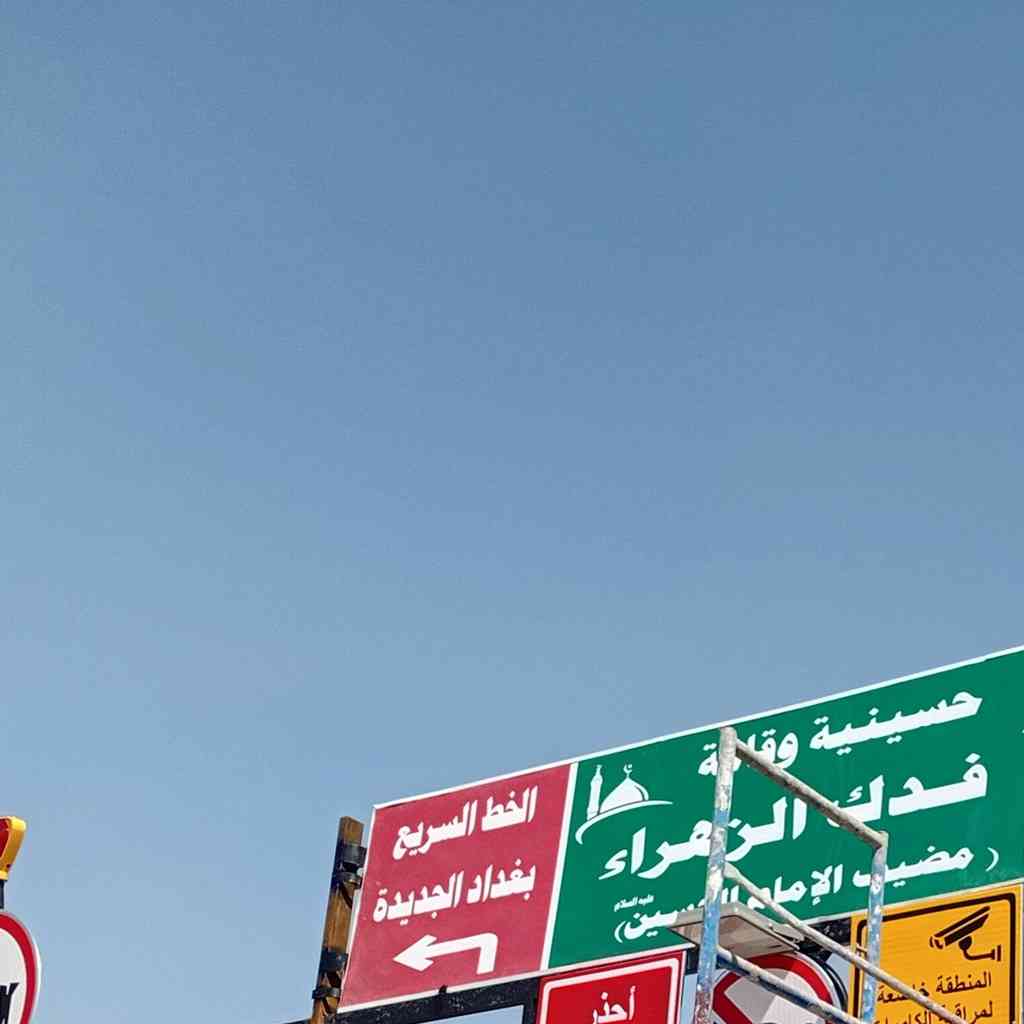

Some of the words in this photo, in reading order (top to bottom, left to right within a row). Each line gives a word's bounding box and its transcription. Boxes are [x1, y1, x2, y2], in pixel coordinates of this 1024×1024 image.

[809, 691, 983, 755] حسينية
[698, 728, 799, 776] وقاة
[481, 786, 538, 831] الخط
[827, 752, 988, 825] فدك
[392, 800, 478, 860] السريع
[599, 796, 808, 879] الزهراء
[373, 870, 464, 925] الجديدة
[466, 858, 536, 904] بغداد
[877, 981, 929, 1004] خعة
[935, 971, 992, 994] المنطقة
